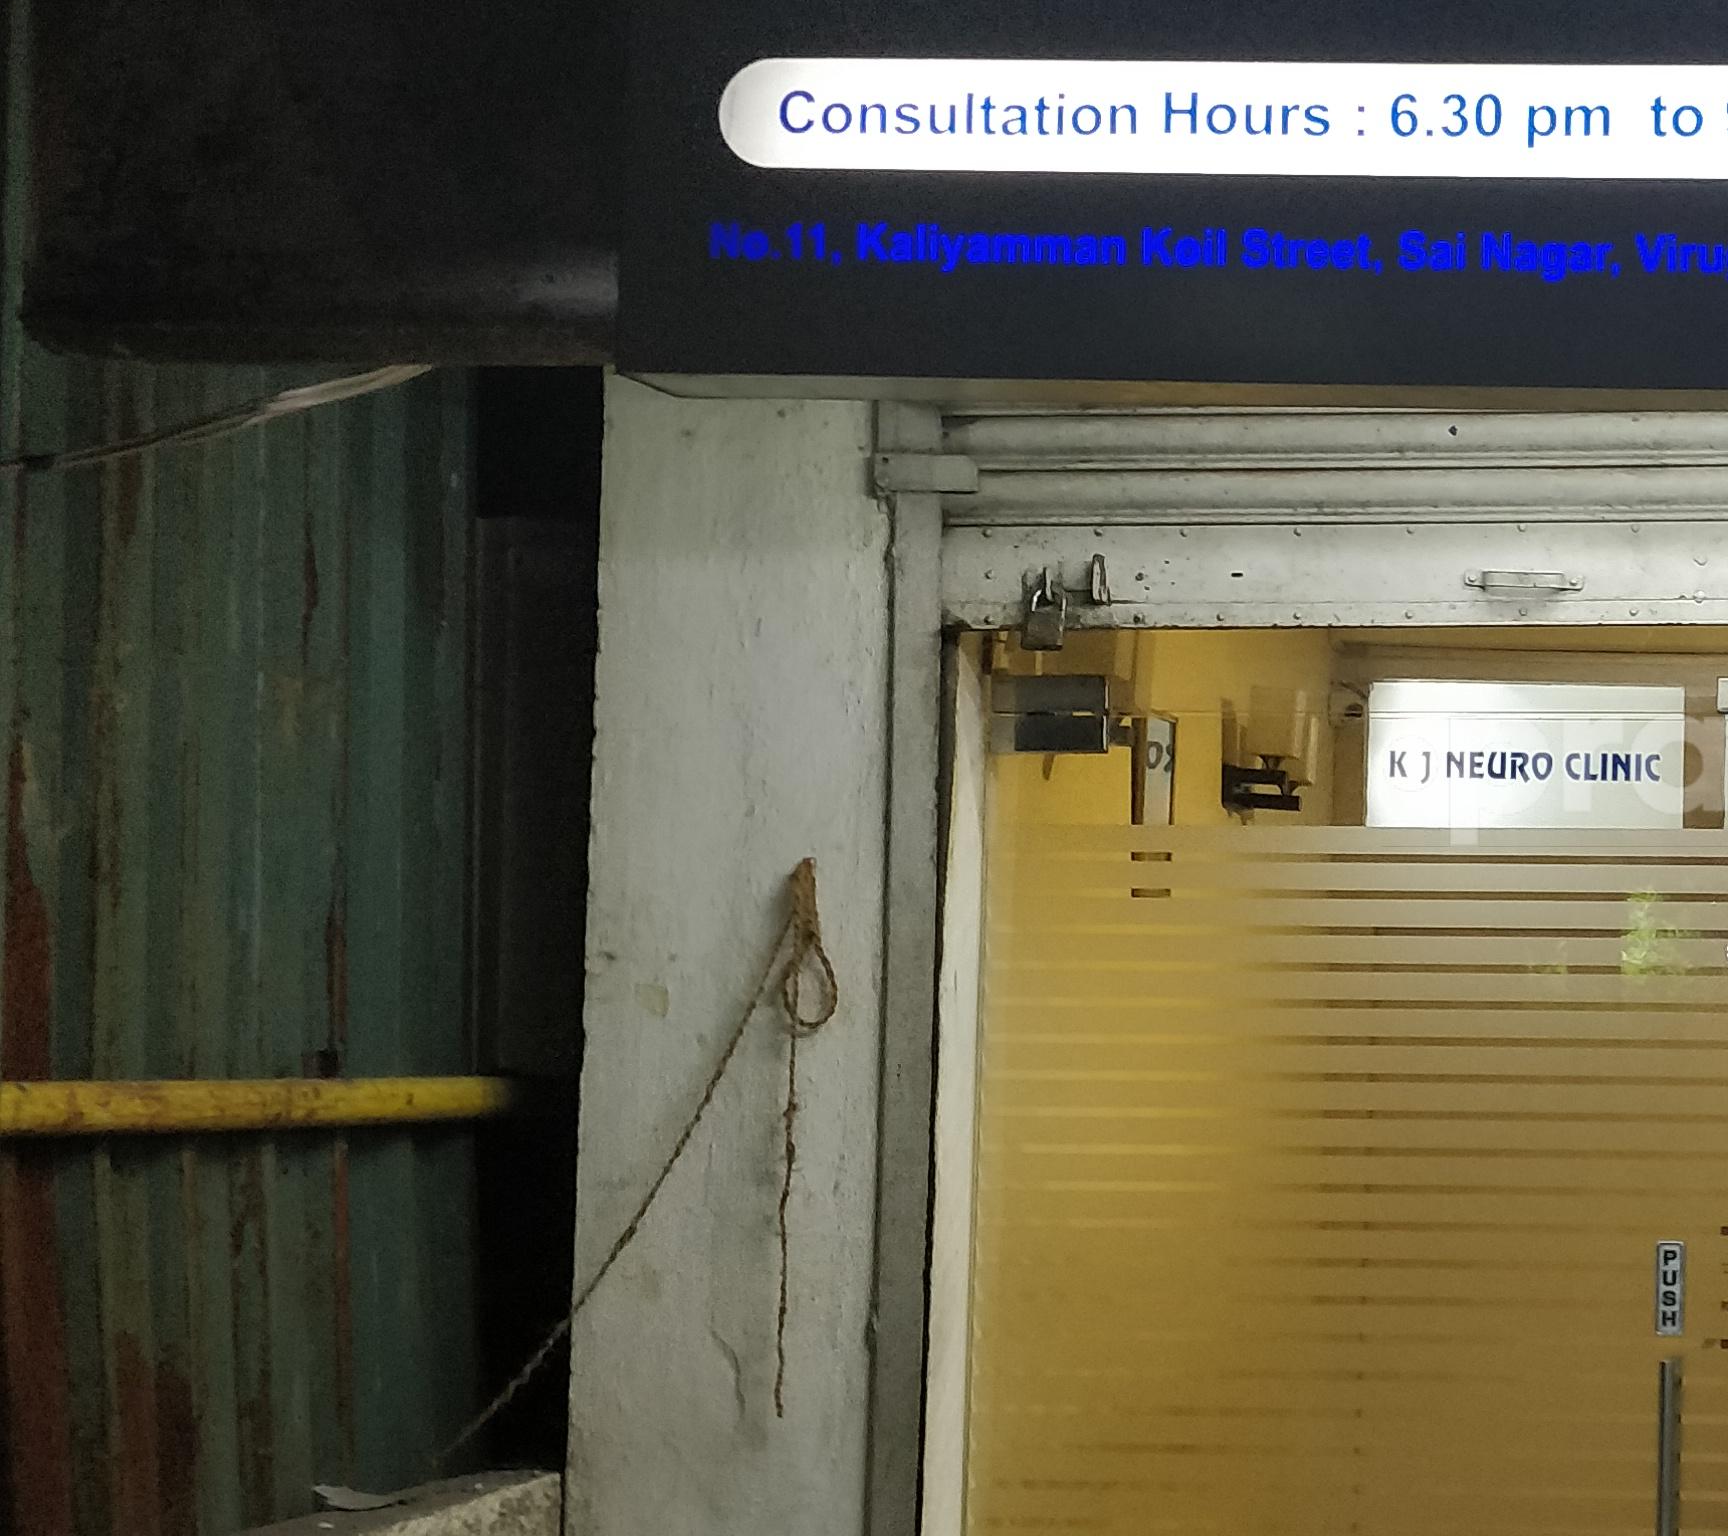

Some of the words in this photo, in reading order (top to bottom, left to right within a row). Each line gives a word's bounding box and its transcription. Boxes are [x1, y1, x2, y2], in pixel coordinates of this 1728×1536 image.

[778, 89, 1138, 136] Consultation
[1162, 91, 1331, 137] Hours
[1388, 93, 1504, 140] 6.30
[1525, 101, 1613, 149] pm
[1650, 95, 1704, 139] to
[857, 222, 1127, 274] Kaliyamman
[1141, 224, 1229, 269] Koil
[1240, 227, 1385, 275] Street,
[1397, 228, 1469, 271] Sai
[1480, 231, 1621, 284] Nagar,
[1388, 750, 1408, 779] K
[1420, 751, 1432, 784] J
[1446, 751, 1554, 786] NEURO
[1564, 752, 1662, 783] CLINIC
[1661, 1249, 1678, 1327] PUSH
